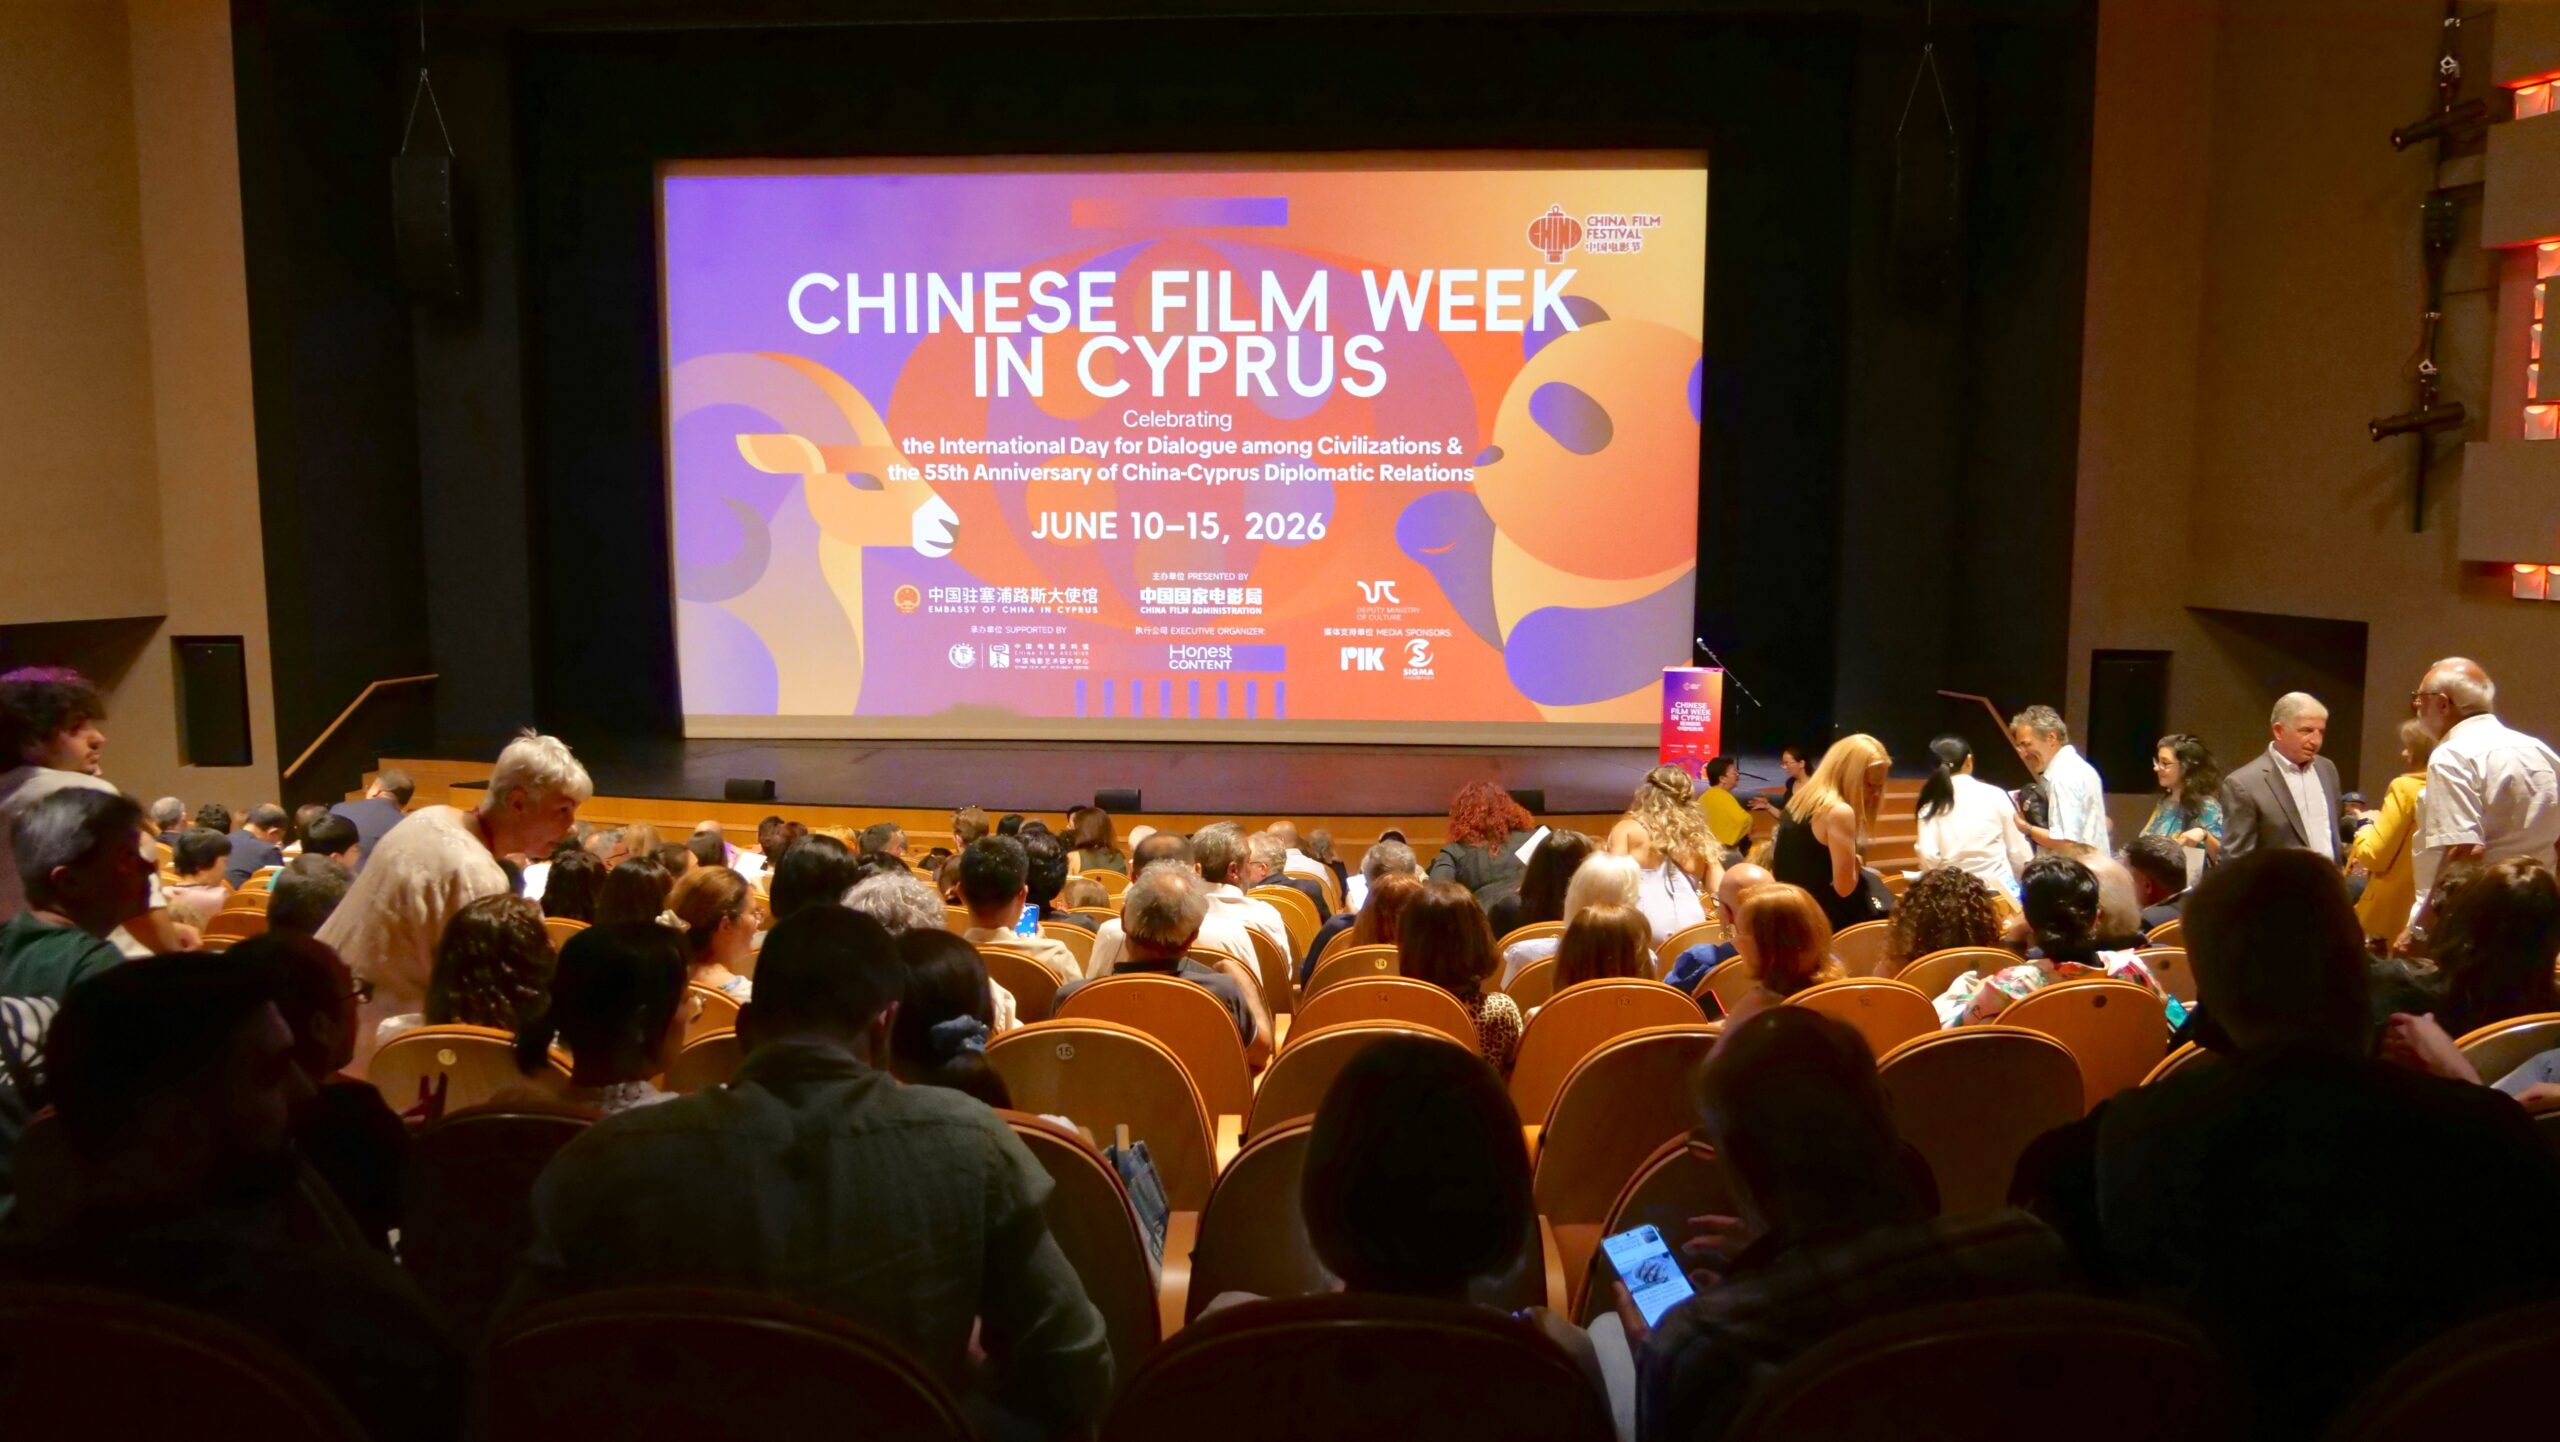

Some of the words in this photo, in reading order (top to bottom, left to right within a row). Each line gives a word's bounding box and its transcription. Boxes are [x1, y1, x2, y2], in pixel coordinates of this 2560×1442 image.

[1586, 215, 1627, 227] CHINA
[1632, 215, 1661, 227] FILM
[1586, 228, 1642, 240] FESTIVAL
[787, 269, 1118, 336] CHINESE
[1151, 269, 1328, 334] FILM
[1361, 268, 1581, 333] WEEK
[974, 336, 1044, 398] IN
[1076, 333, 1388, 399] CYPRUS
[1122, 409, 1233, 432] Celebrating
[902, 436, 935, 455] the
[939, 435, 1066, 455] International
[1070, 437, 1110, 459] Day
[1114, 436, 1143, 455] for
[1146, 436, 1238, 459] Dialogue
[1241, 440, 1313, 460] among
[1317, 435, 1442, 455] Civilizations
[1446, 437, 1464, 456] &
[887, 463, 921, 481] the
[924, 463, 969, 481] 55th
[973, 463, 1093, 486] Anniversary
[1096, 462, 1118, 481] of
[1121, 462, 1261, 486] China-Cyprus
[1264, 463, 1375, 486] Diplomatic
[1379, 463, 1475, 482] Relations
[1031, 511, 1118, 540] JUNE
[1244, 511, 1327, 541] 2026
[1187, 572, 1236, 581] PRESENTED
[1238, 572, 1249, 581] BY
[928, 586, 1098, 604] 中国驻塞浦路斯大使馆
[1139, 587, 1262, 605] 中国国家电影局
[928, 606, 976, 614] EMBASSY
[982, 606, 996, 614] OF
[1002, 606, 1035, 614] CHINA
[1040, 606, 1052, 614] IN
[1057, 606, 1099, 614] CYPRUS
[1140, 606, 1167, 614] CHINA
[1169, 606, 1189, 614] FILM
[1191, 606, 1262, 615] ADMINISTRATION
[1357, 606, 1384, 614] DEPUTY
[1386, 606, 1420, 614] MINISTRY
[1005, 626, 1054, 635] SUPPORTED
[1056, 626, 1067, 635] BY
[1170, 626, 1215, 635] EXECUTIVE
[1376, 628, 1403, 637] MEDIA
[1169, 644, 1232, 660] Honest
[1169, 659, 1232, 670] CONTENT
[1403, 668, 1435, 676] SIGMA
[1058, 1046, 1073, 1056] 15
